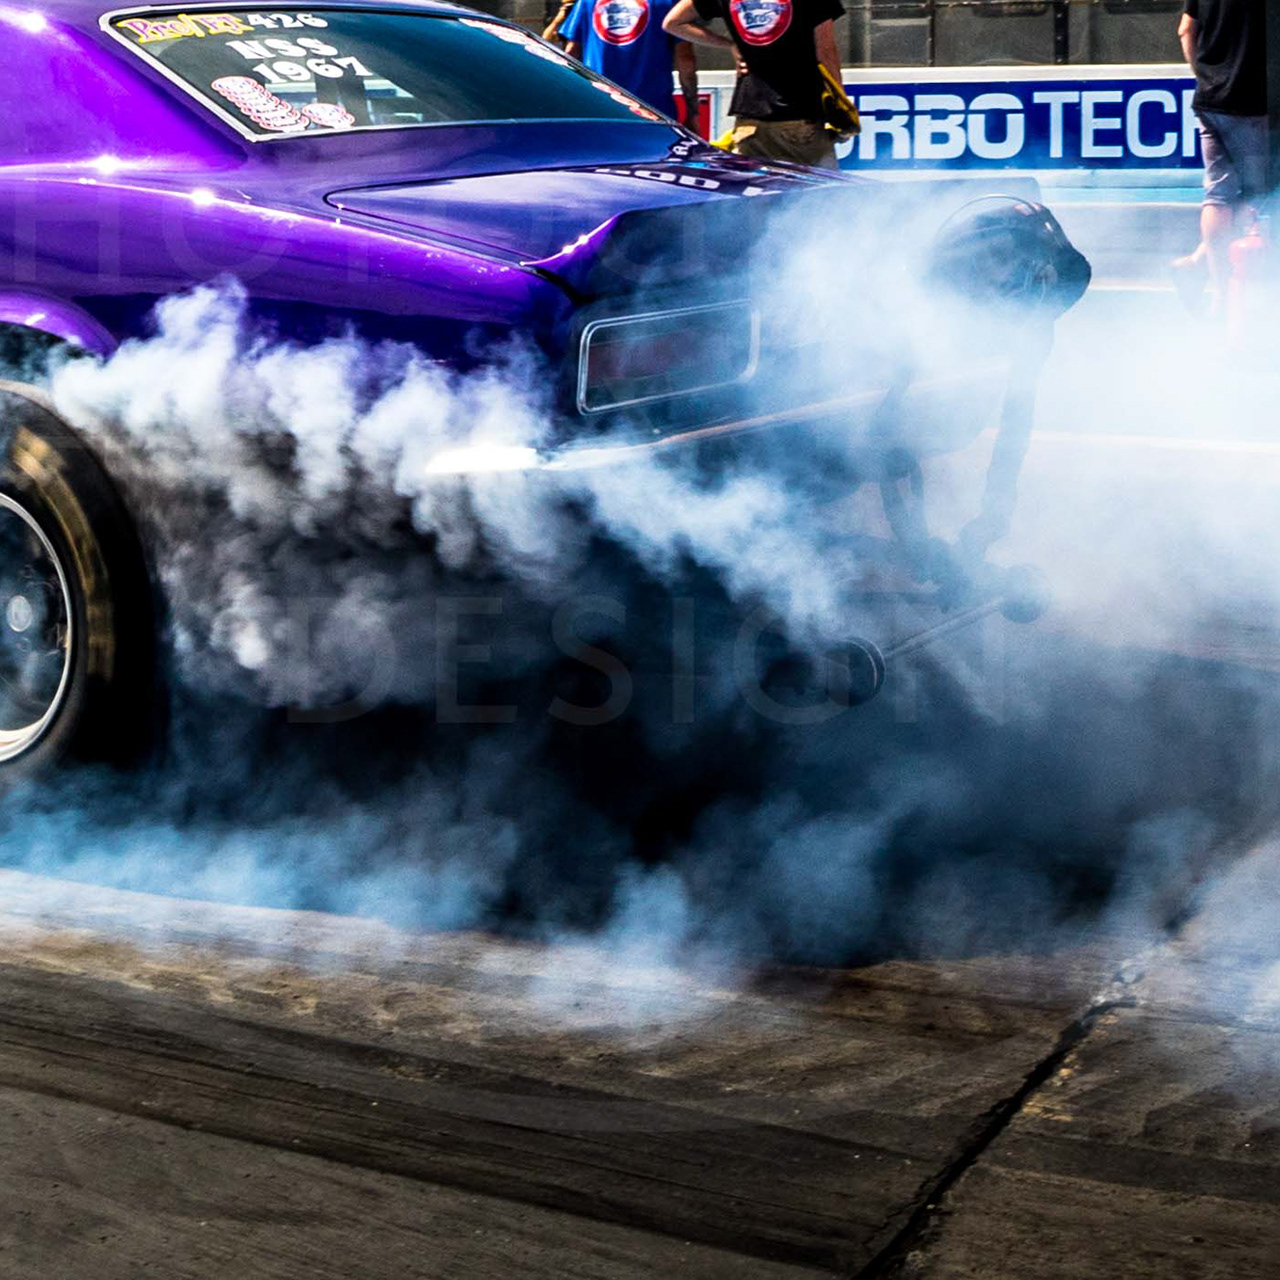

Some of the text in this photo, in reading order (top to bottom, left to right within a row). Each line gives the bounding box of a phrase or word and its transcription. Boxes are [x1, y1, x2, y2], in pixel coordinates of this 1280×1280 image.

[246, 13, 329, 29] 426
[226, 37, 339, 60] NSS
[253, 56, 373, 84] 1967
